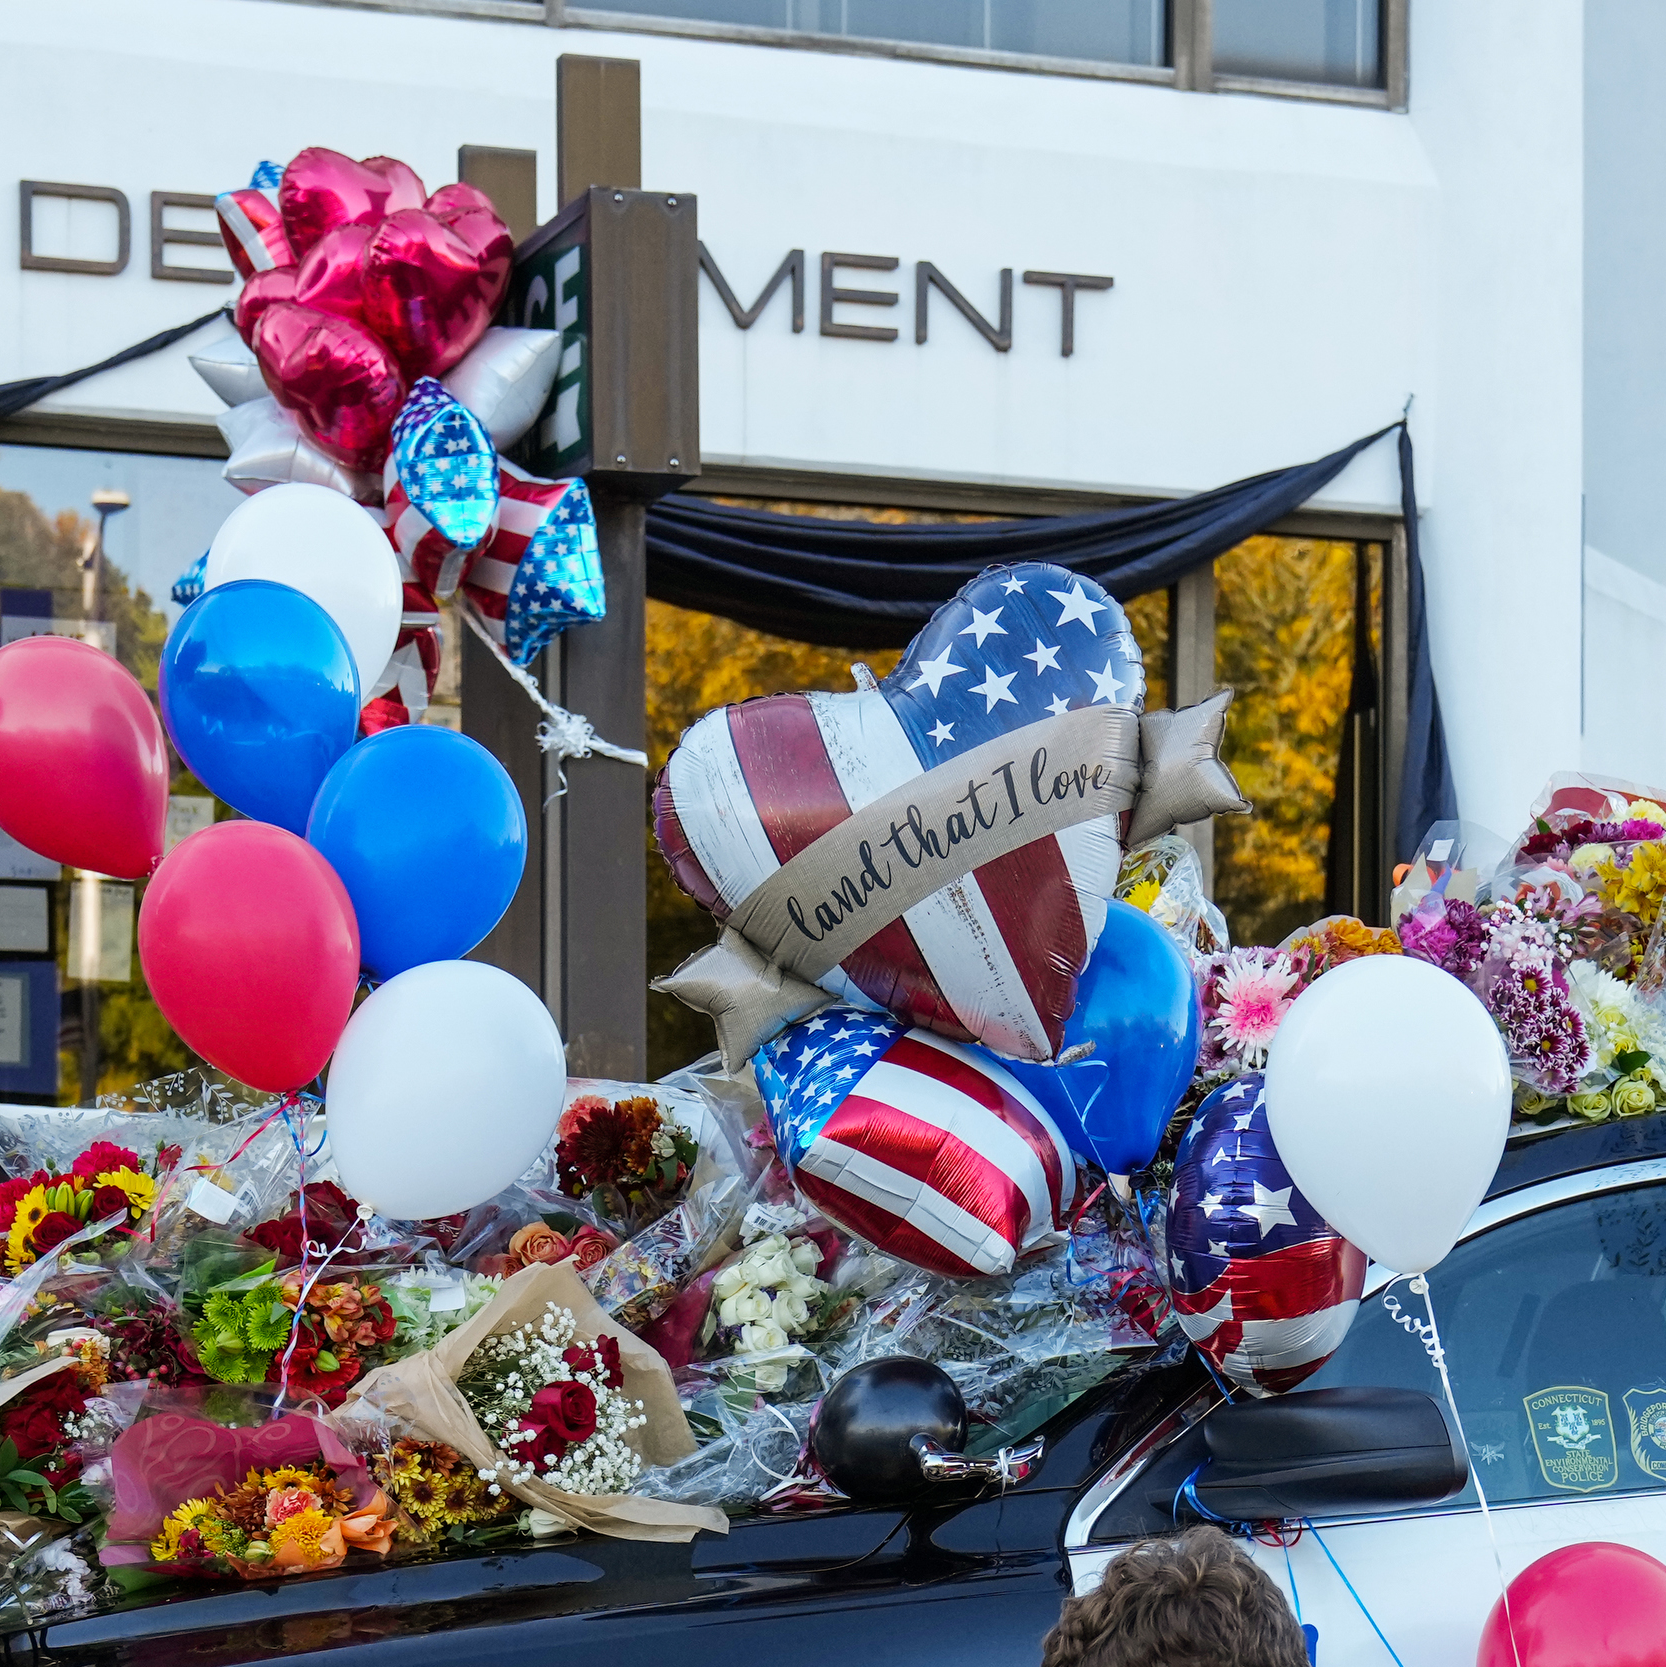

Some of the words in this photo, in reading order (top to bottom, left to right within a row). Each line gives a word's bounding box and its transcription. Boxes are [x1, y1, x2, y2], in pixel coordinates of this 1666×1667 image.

[20, 179, 1115, 357] DEMENT
[787, 842, 893, 942] land
[882, 779, 999, 870] that
[993, 761, 1022, 824] I
[1030, 746, 1111, 806] love
[1532, 1394, 1602, 1410] CONNECTICUT
[1565, 1450, 1591, 1458] STATE
[1545, 1456, 1613, 1467] ENVIRONMENTAL
[1552, 1465, 1609, 1473] CONSERVATION
[1562, 1471, 1605, 1483] POLICE
